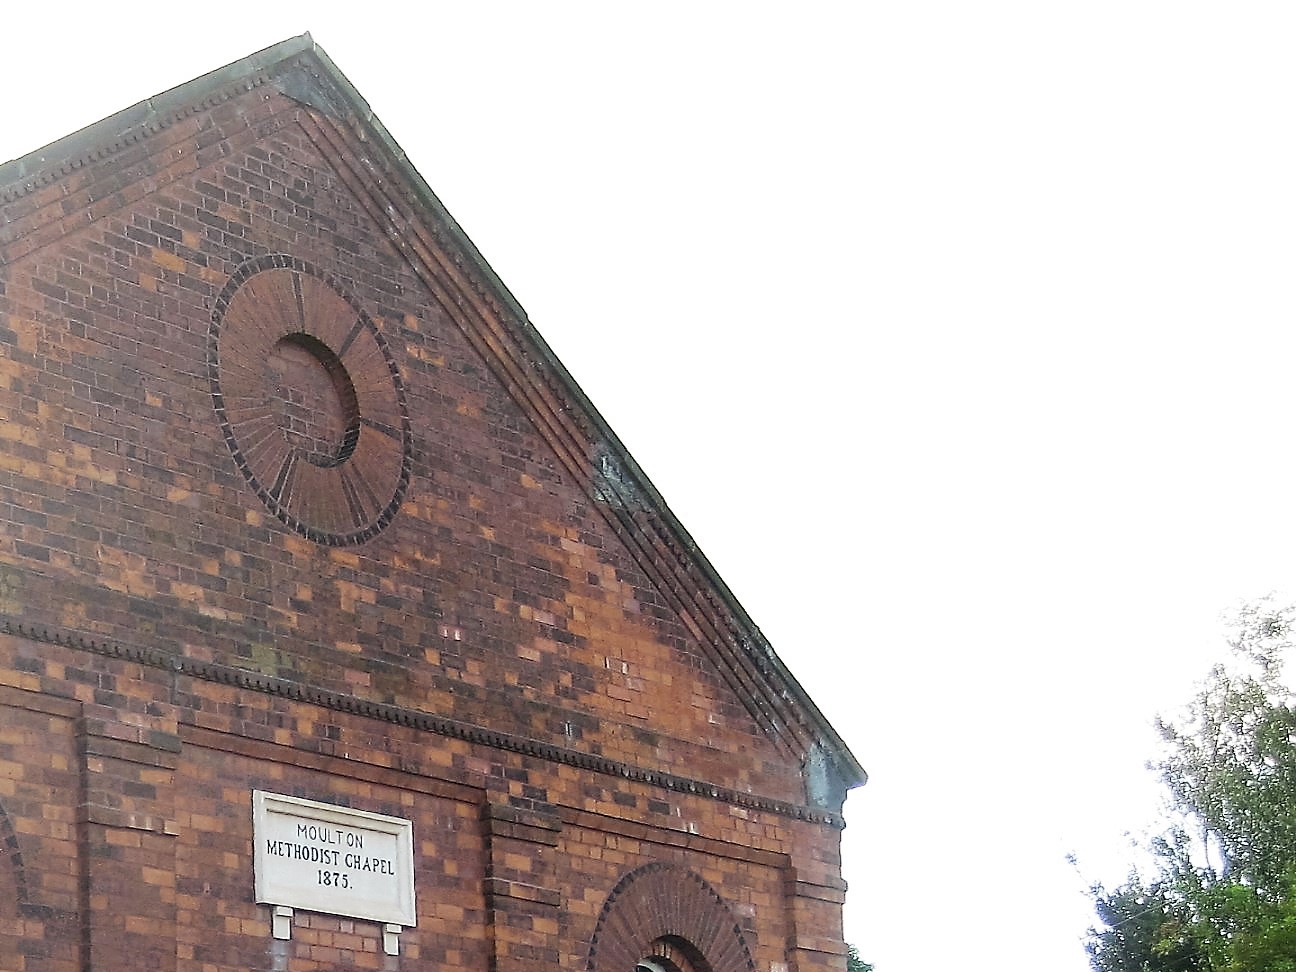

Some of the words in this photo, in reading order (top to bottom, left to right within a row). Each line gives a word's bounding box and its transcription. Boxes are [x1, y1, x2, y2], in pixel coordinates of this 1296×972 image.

[297, 824, 363, 848] MOULTON
[267, 840, 340, 866] METHODIST
[345, 853, 395, 876] CHAPEL
[317, 869, 353, 890] 1875.
